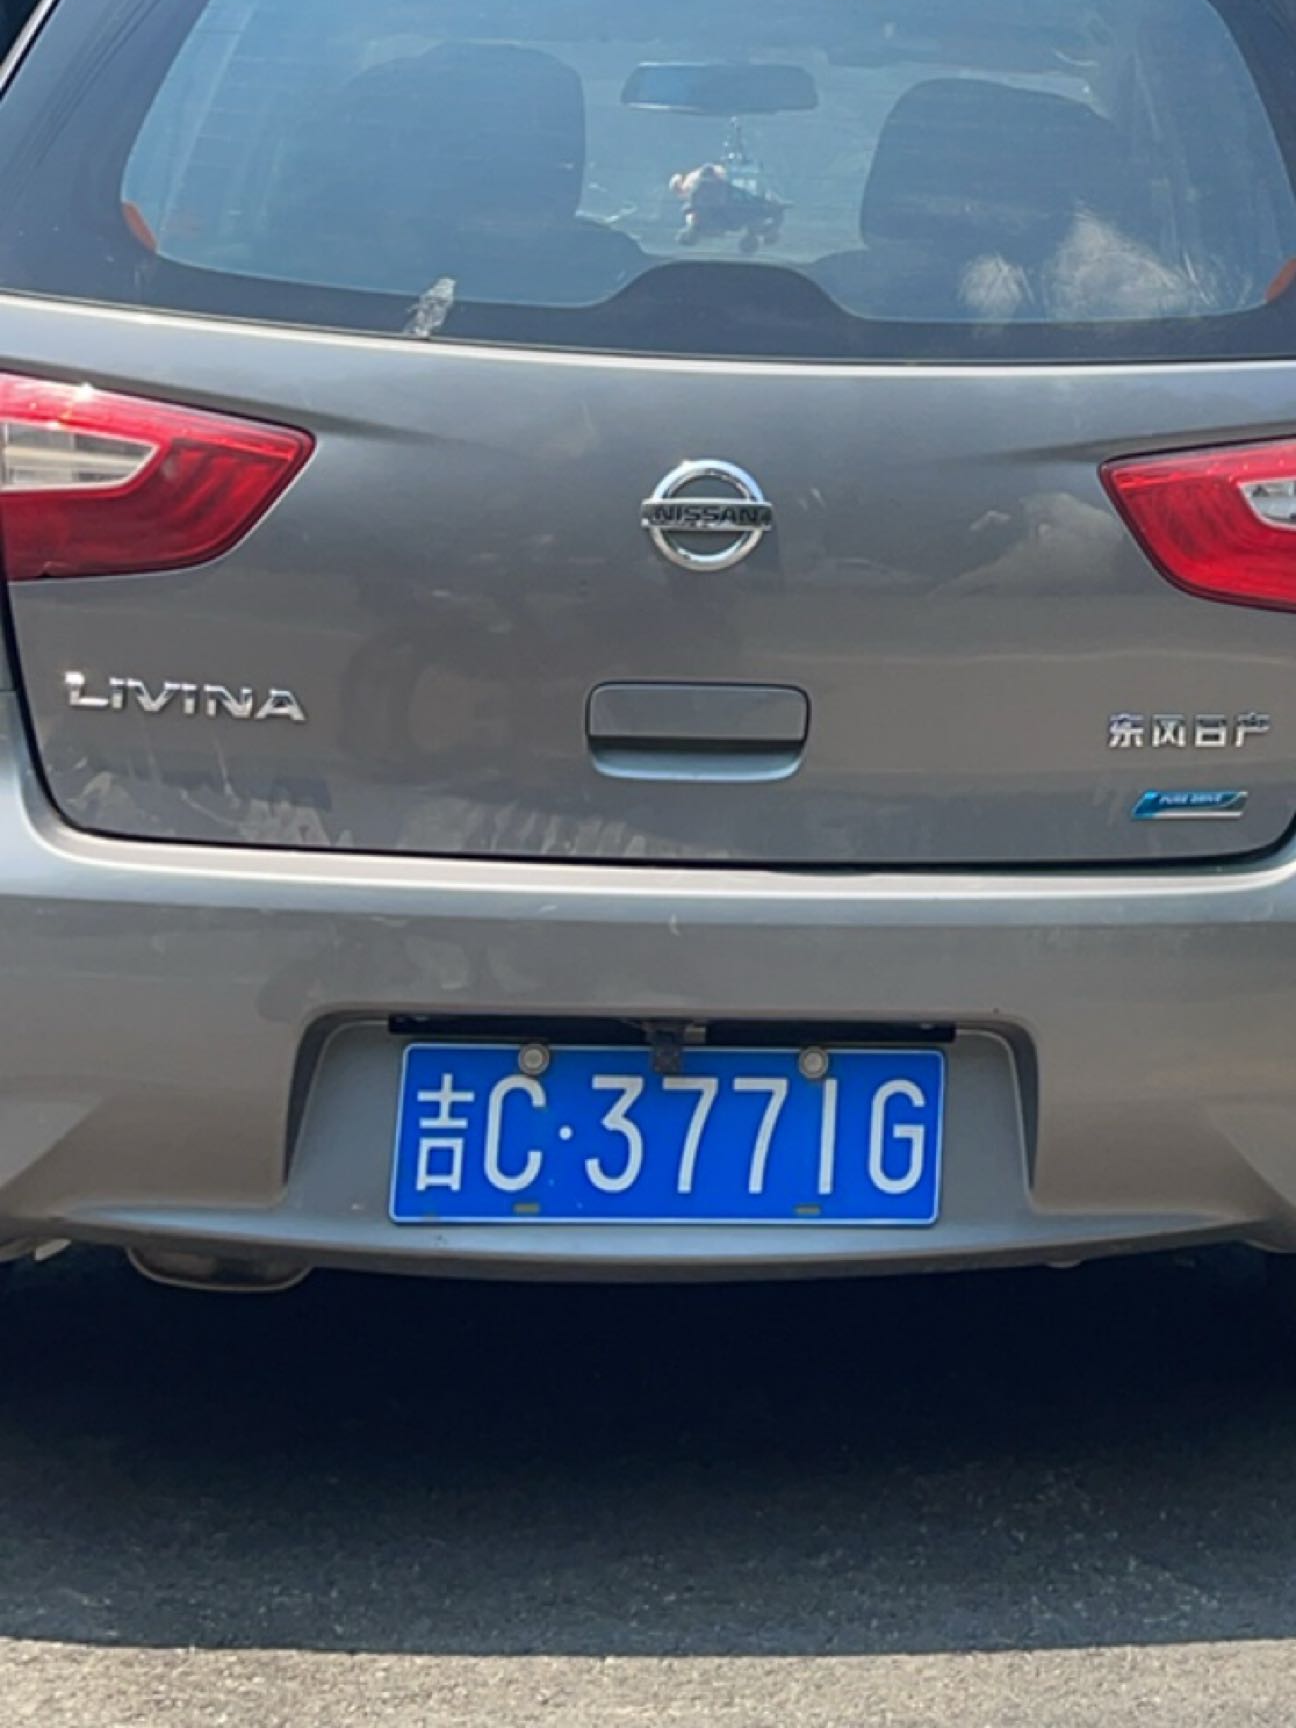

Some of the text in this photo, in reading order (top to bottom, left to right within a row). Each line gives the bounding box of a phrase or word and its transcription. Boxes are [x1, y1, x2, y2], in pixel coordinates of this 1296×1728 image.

[653, 504, 760, 523] NISSAN
[64, 671, 306, 721] LIVINA
[1107, 711, 1272, 748] 东风日产
